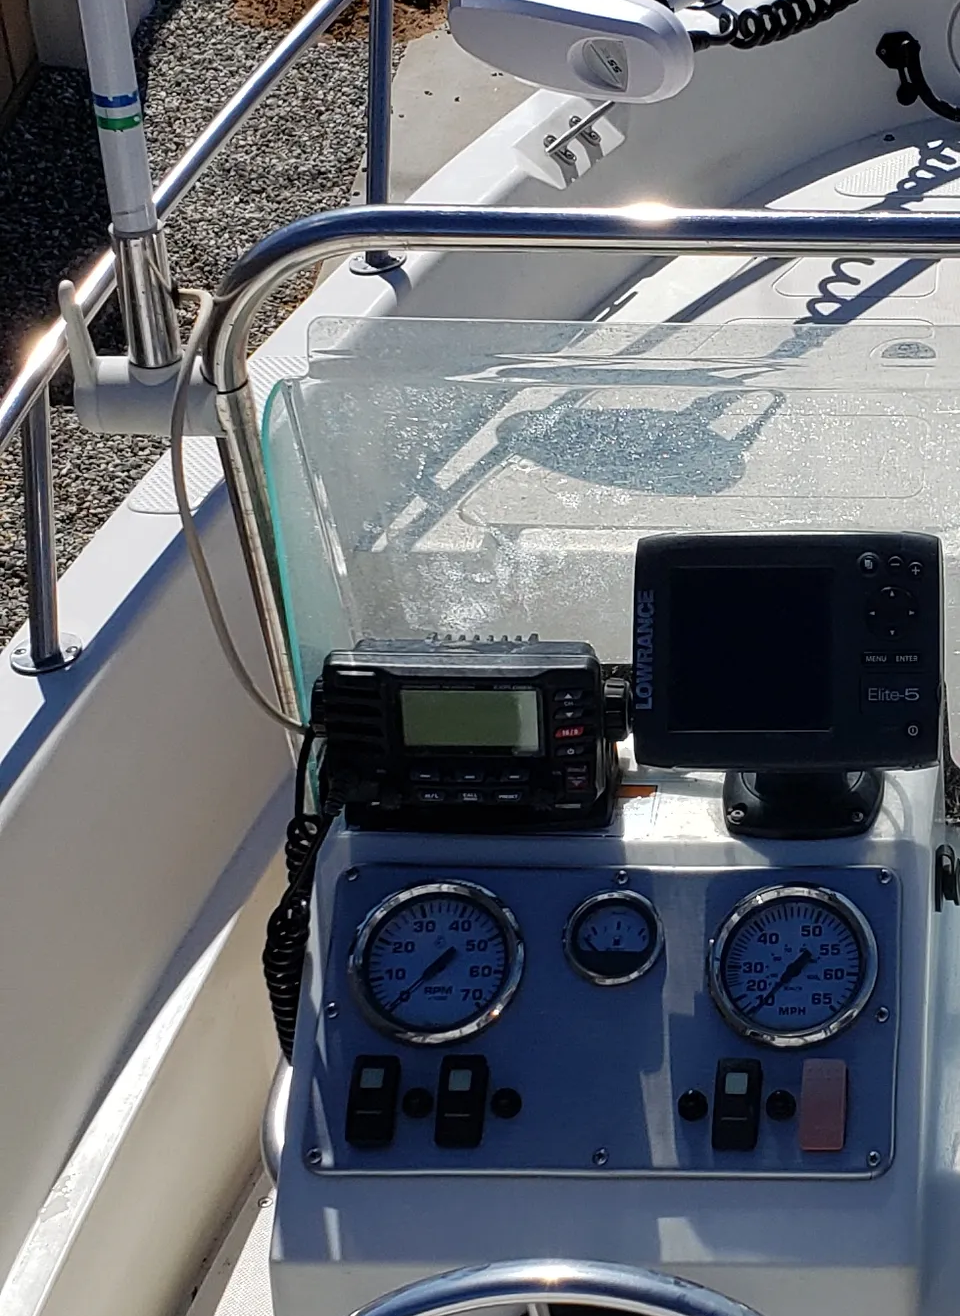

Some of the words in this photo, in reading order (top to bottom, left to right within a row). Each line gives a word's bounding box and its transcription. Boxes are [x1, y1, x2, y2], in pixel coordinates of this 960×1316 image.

[635, 589, 655, 710] LOWRANCE
[865, 655, 887, 663] MENU
[895, 655, 918, 663] ENTER
[868, 687, 920, 702] Elite-5
[413, 920, 436, 933] 30
[448, 919, 472, 933] 40
[801, 925, 823, 938] 50
[757, 932, 779, 945] 40
[392, 940, 415, 954] 20
[465, 939, 488, 952] 50
[819, 943, 841, 956] 55
[385, 967, 406, 980] 10
[469, 965, 493, 978] 60
[742, 961, 765, 974] 30
[823, 968, 845, 981] 60
[423, 985, 454, 995] RPM
[746, 979, 767, 992] 20
[460, 989, 483, 1002] 70
[811, 992, 833, 1005] 65
[778, 1006, 807, 1016] MPH
